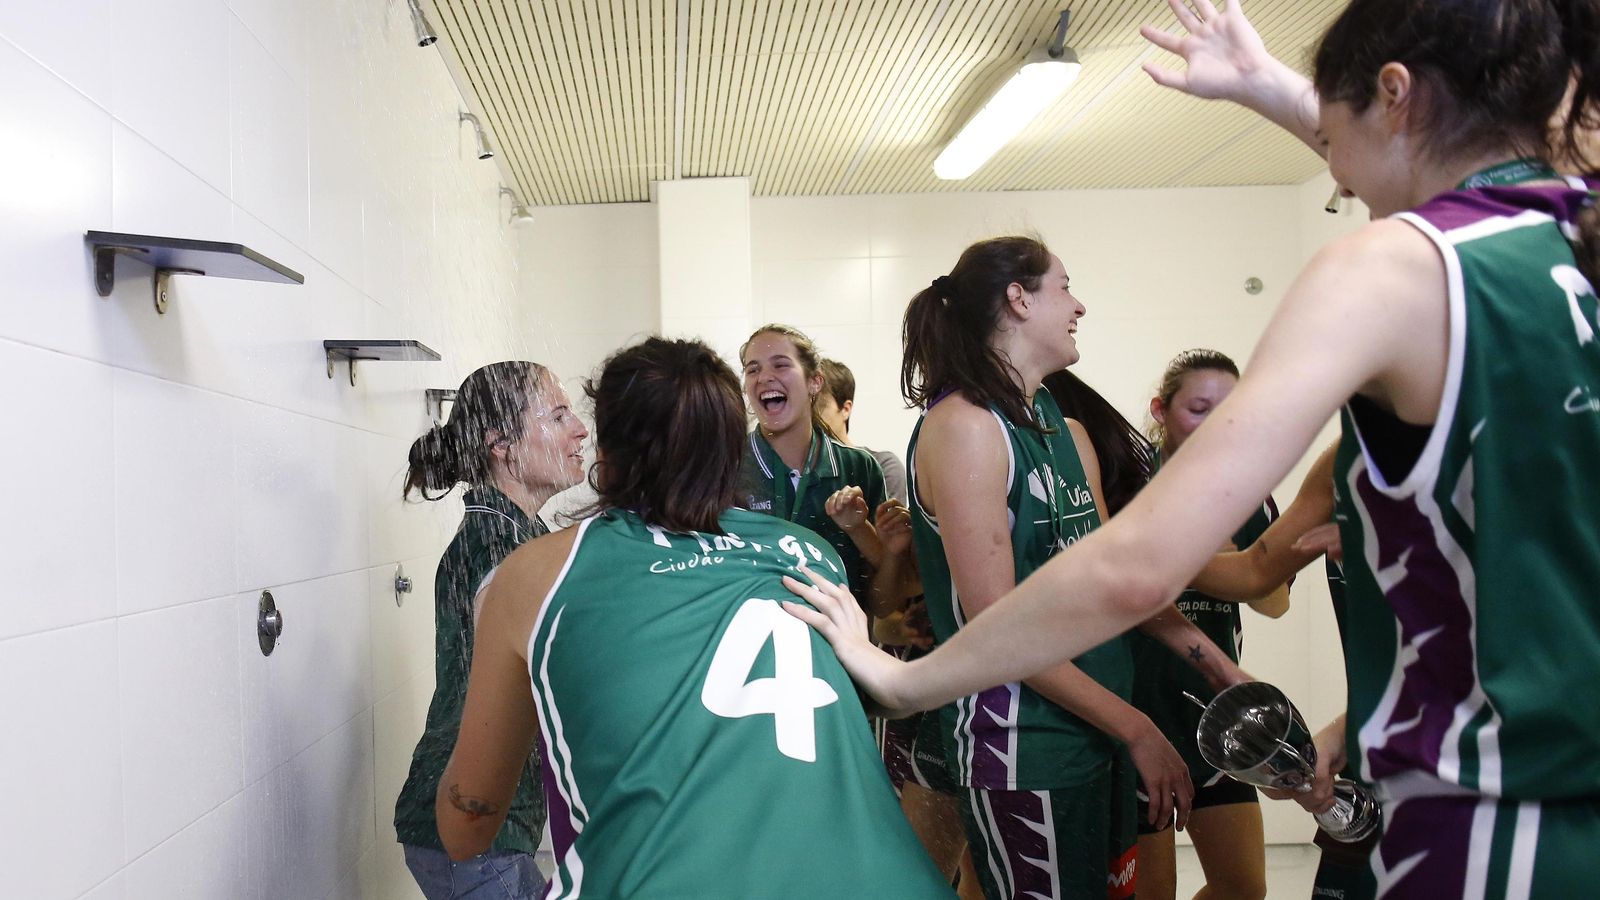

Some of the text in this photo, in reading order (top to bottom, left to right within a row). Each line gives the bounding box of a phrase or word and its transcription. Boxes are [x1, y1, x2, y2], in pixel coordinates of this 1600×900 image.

[1177, 601, 1191, 612] STA
[1192, 601, 1212, 611] DEL
[701, 598, 839, 763] 4
